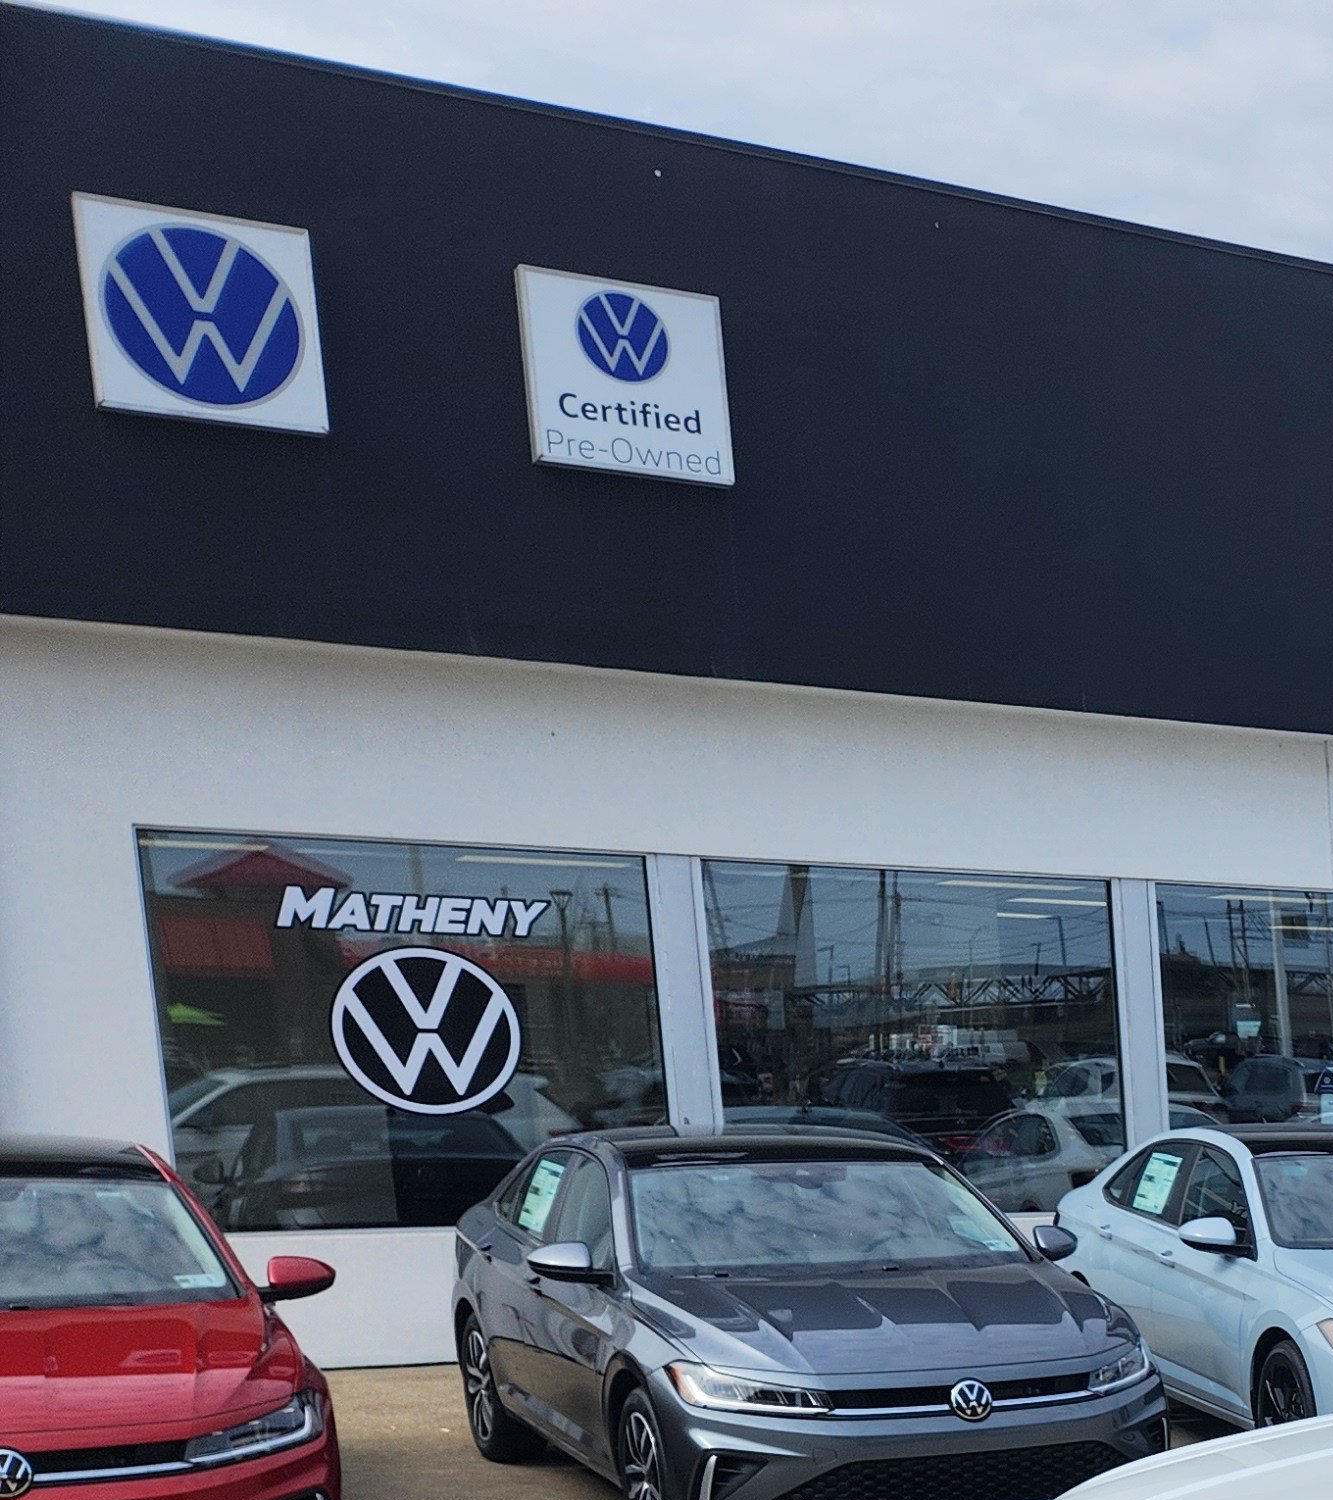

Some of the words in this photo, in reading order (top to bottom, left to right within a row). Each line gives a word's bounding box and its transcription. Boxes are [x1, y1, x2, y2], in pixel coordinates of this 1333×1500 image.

[103, 225, 298, 397] VW
[577, 292, 667, 379] VW
[558, 392, 702, 434] Certified
[546, 429, 722, 475] Pre-Owned
[277, 885, 549, 937] MATHENY
[340, 955, 510, 1101] VW
